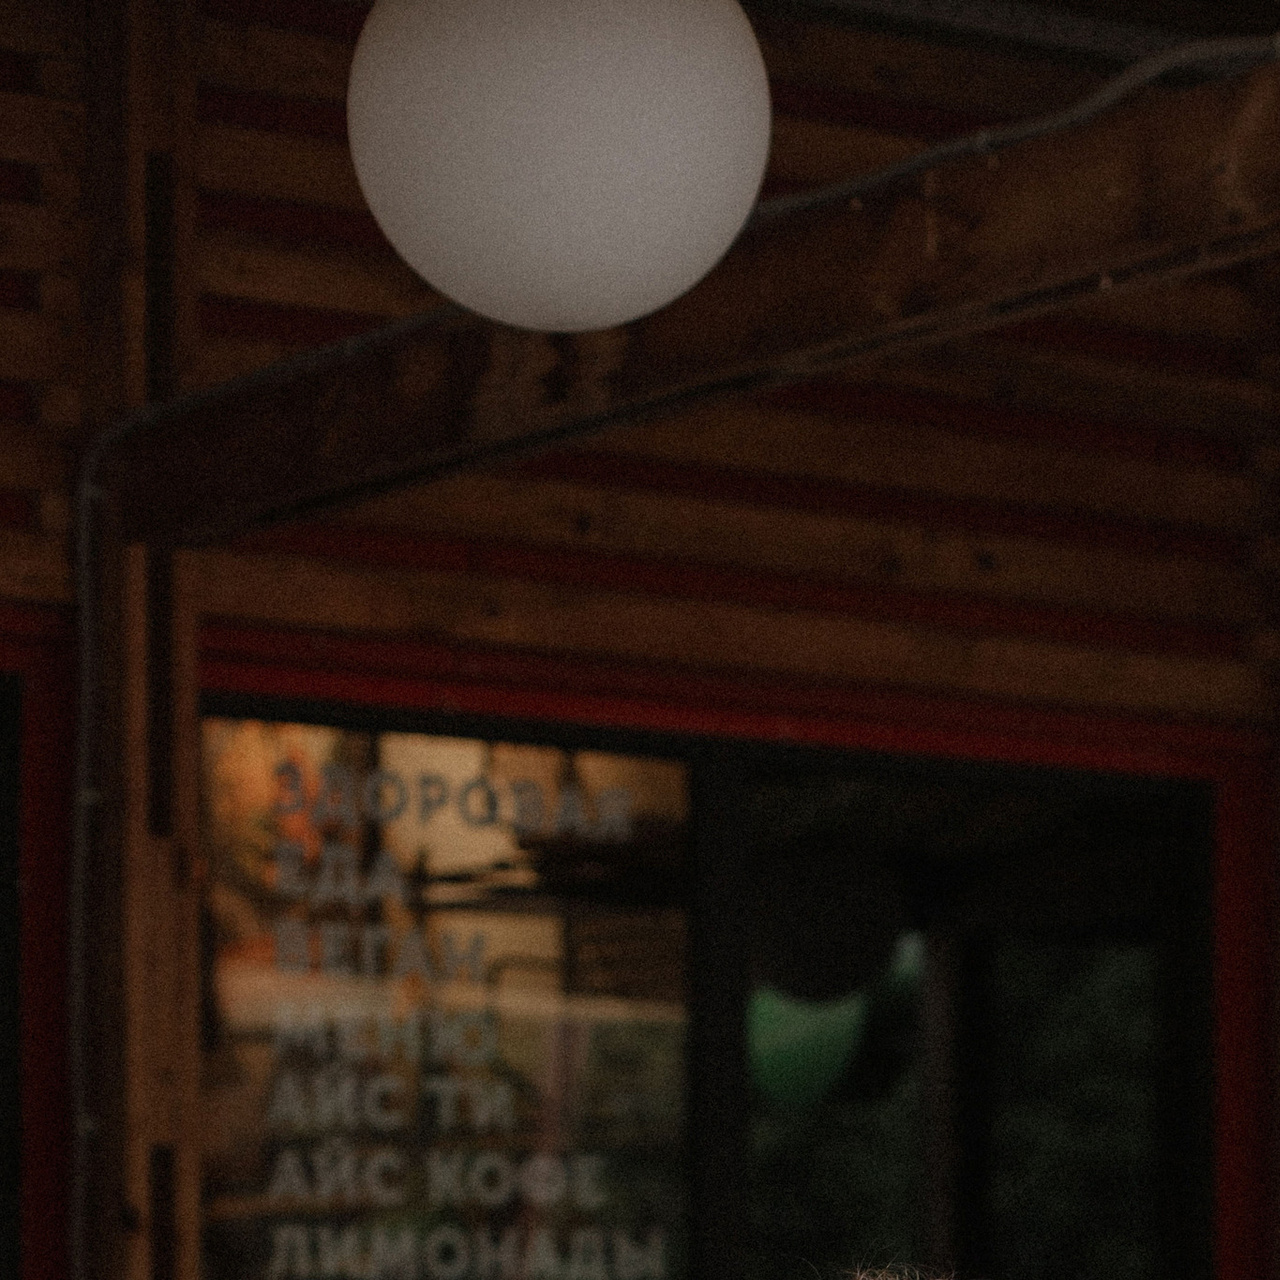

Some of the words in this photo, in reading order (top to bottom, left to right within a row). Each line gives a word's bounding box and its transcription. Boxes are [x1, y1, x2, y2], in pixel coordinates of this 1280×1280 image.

[272, 843, 407, 905] ЕДА
[273, 920, 486, 983] ВЕГАН
[270, 1002, 498, 1066] МЕНЮ
[266, 1070, 405, 1131] АЙС
[423, 1080, 516, 1131] ТИ
[266, 1144, 405, 1206] АЙС
[426, 1153, 609, 1207] КОФЕ
